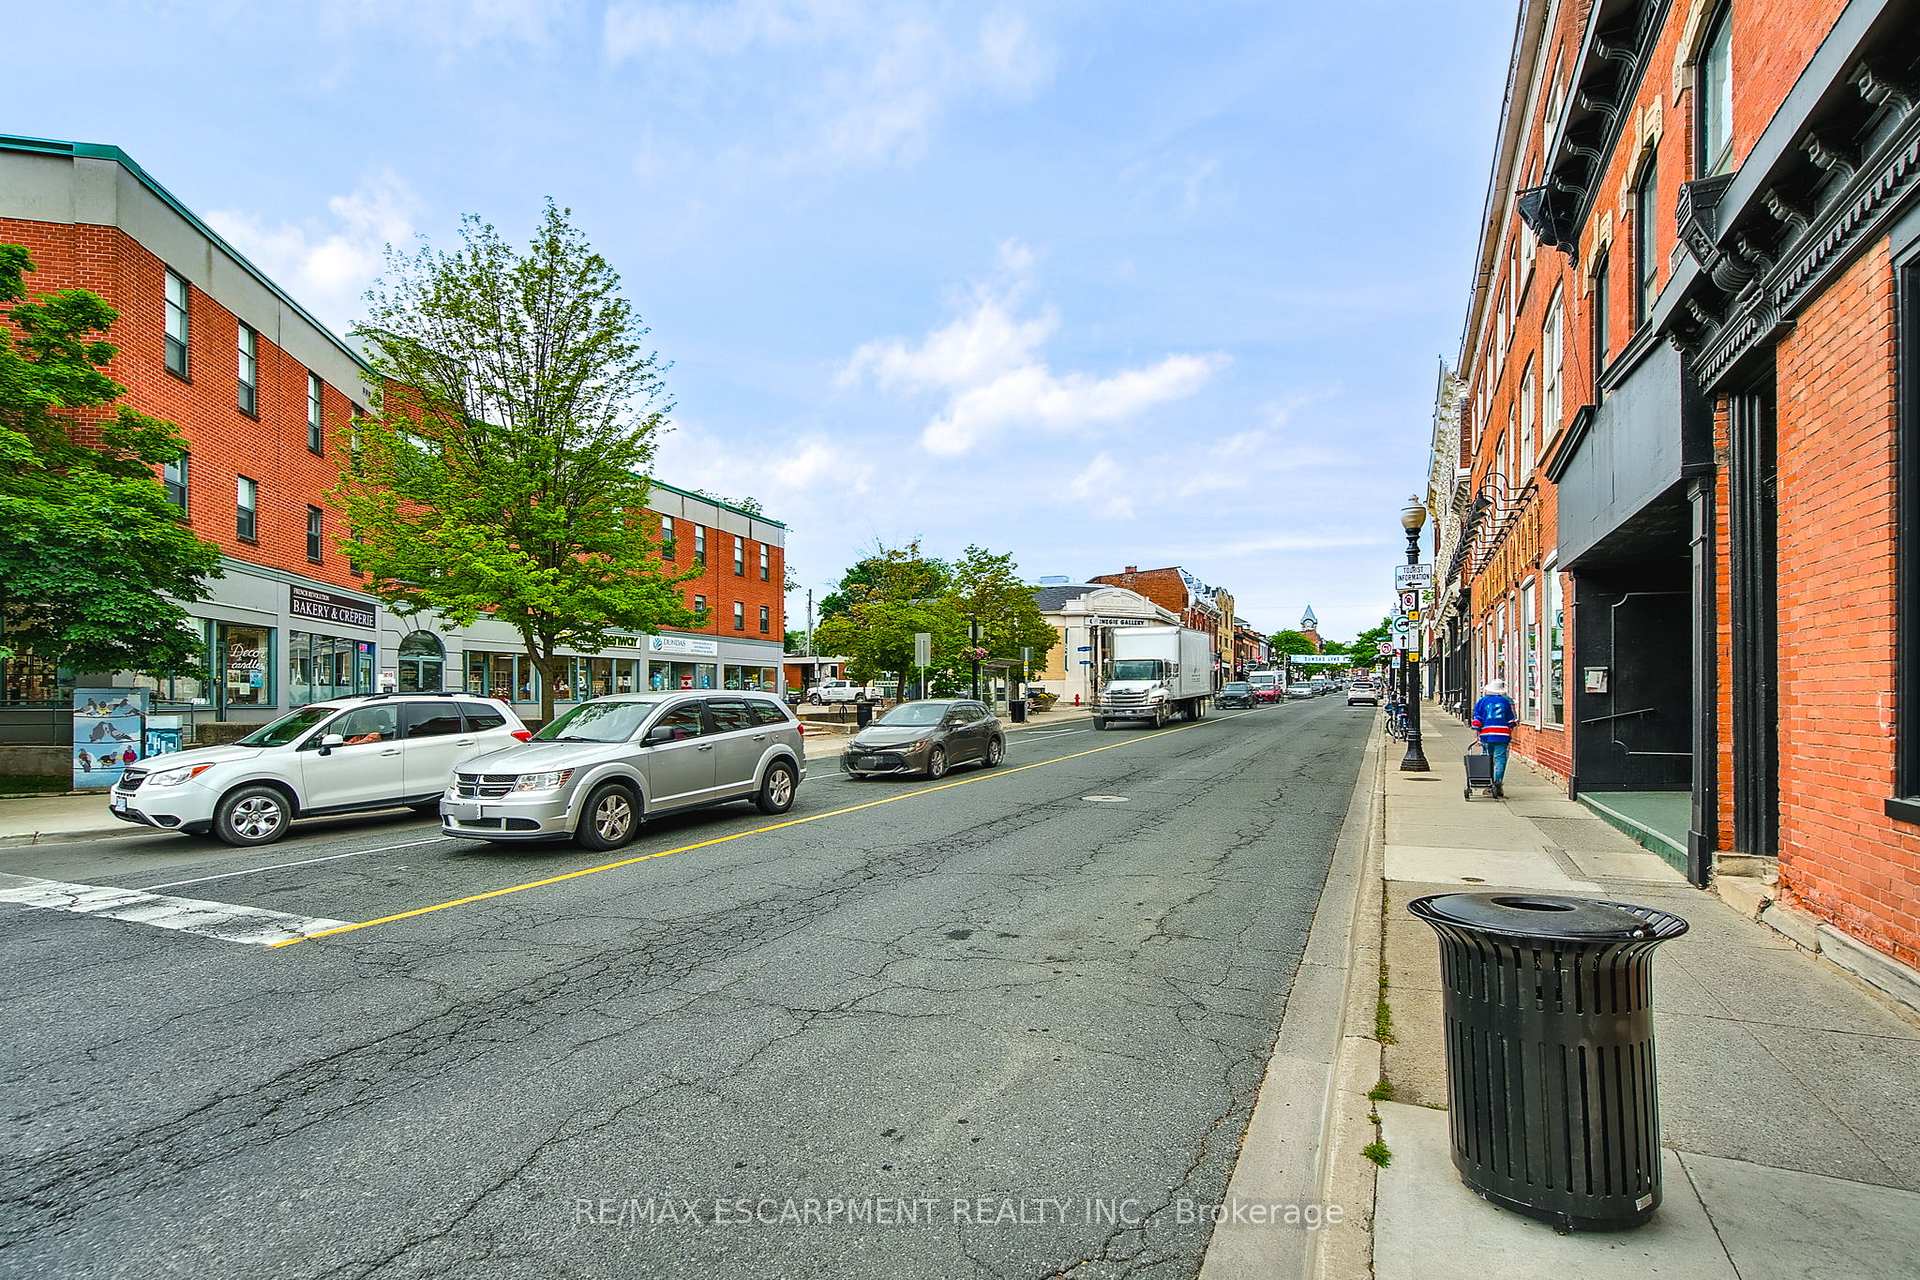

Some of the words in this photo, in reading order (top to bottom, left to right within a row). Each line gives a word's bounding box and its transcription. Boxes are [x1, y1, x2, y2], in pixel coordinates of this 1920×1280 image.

[1397, 573, 1429, 581] INFORMATION
[293, 599, 330, 618] BAKERY
[331, 607, 338, 620] &
